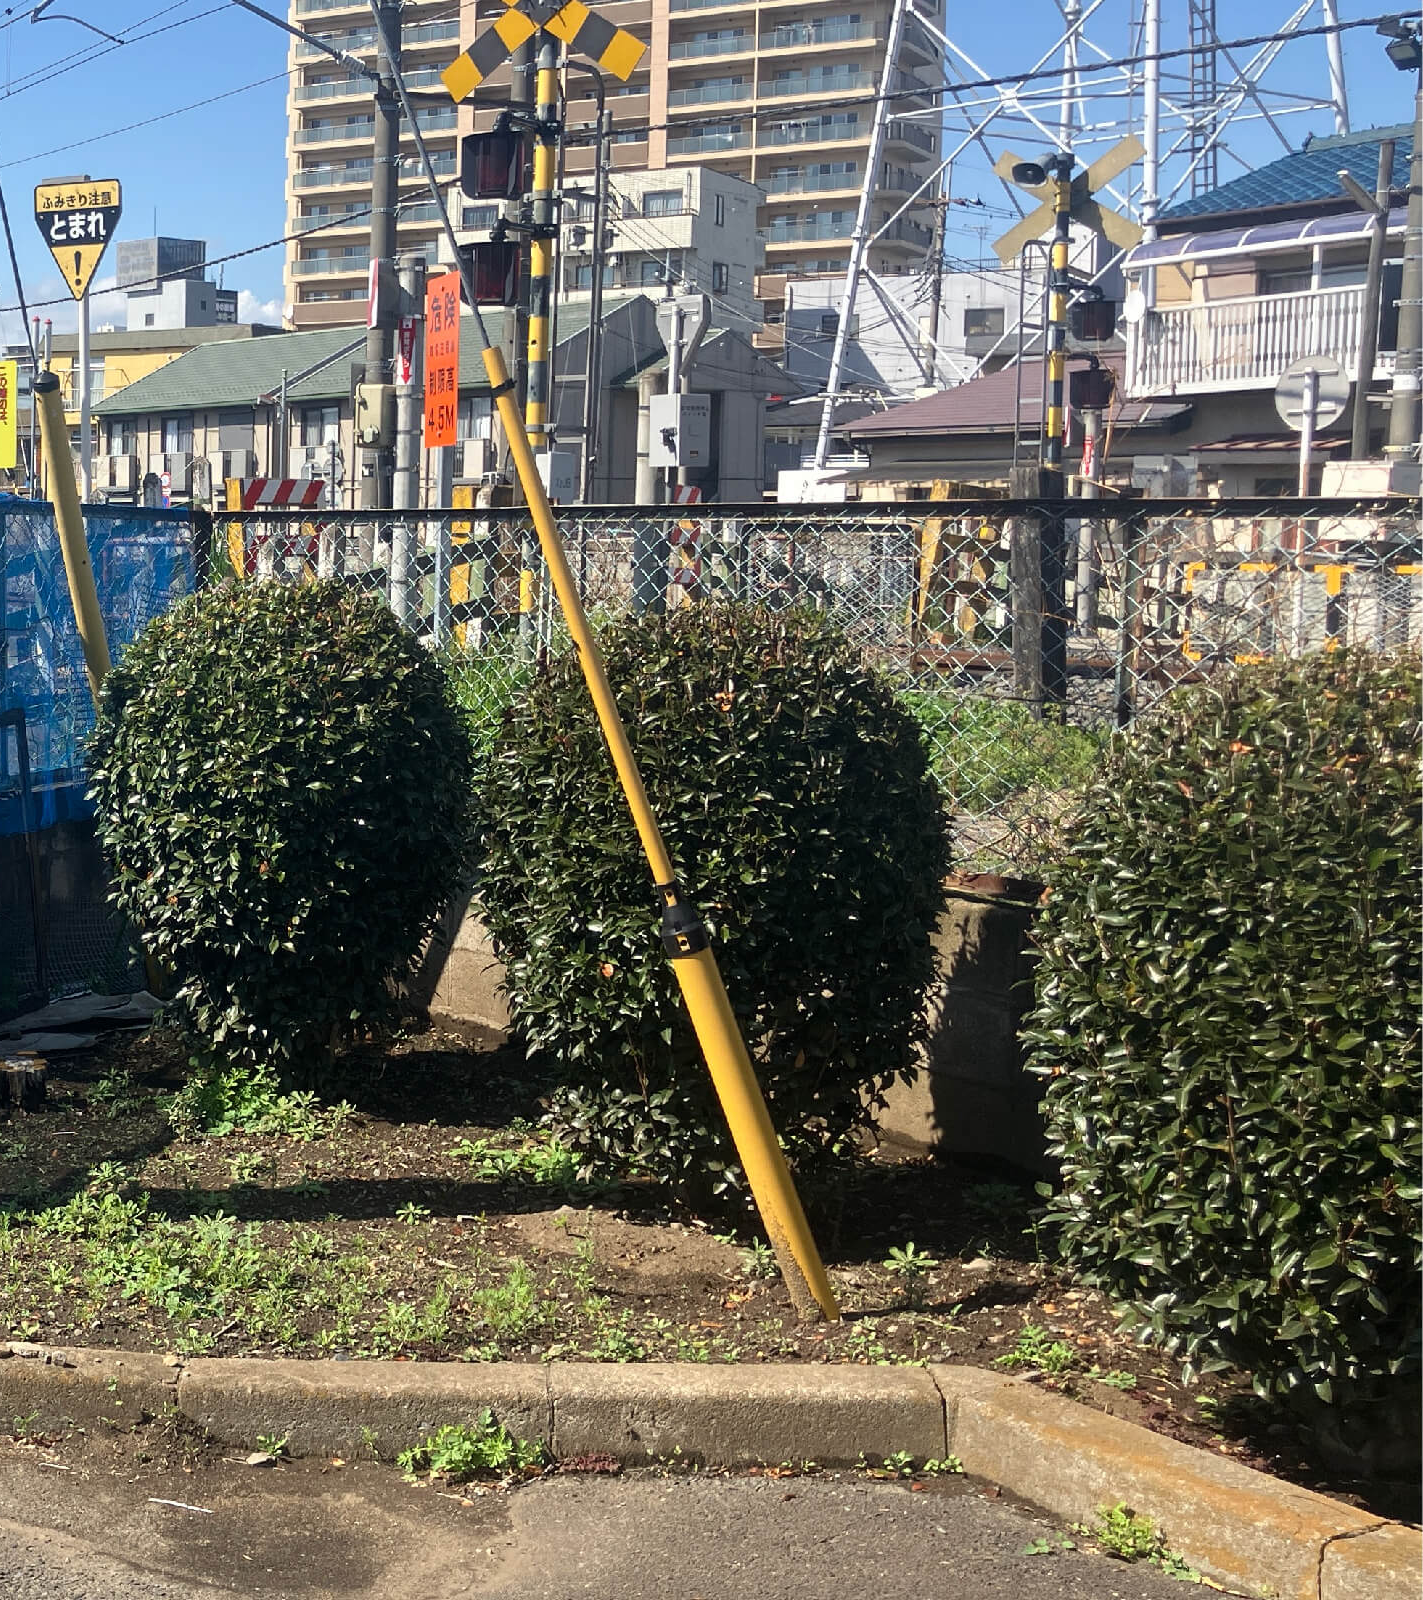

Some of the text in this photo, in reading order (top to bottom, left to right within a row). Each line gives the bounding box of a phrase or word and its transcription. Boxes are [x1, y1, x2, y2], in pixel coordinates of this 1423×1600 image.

[42, 191, 112, 209] ふみきり注意
[49, 211, 107, 241] とまれ
[430, 291, 456, 334] 危険
[429, 366, 455, 396] 制限高
[428, 404, 455, 433] 4.5M
